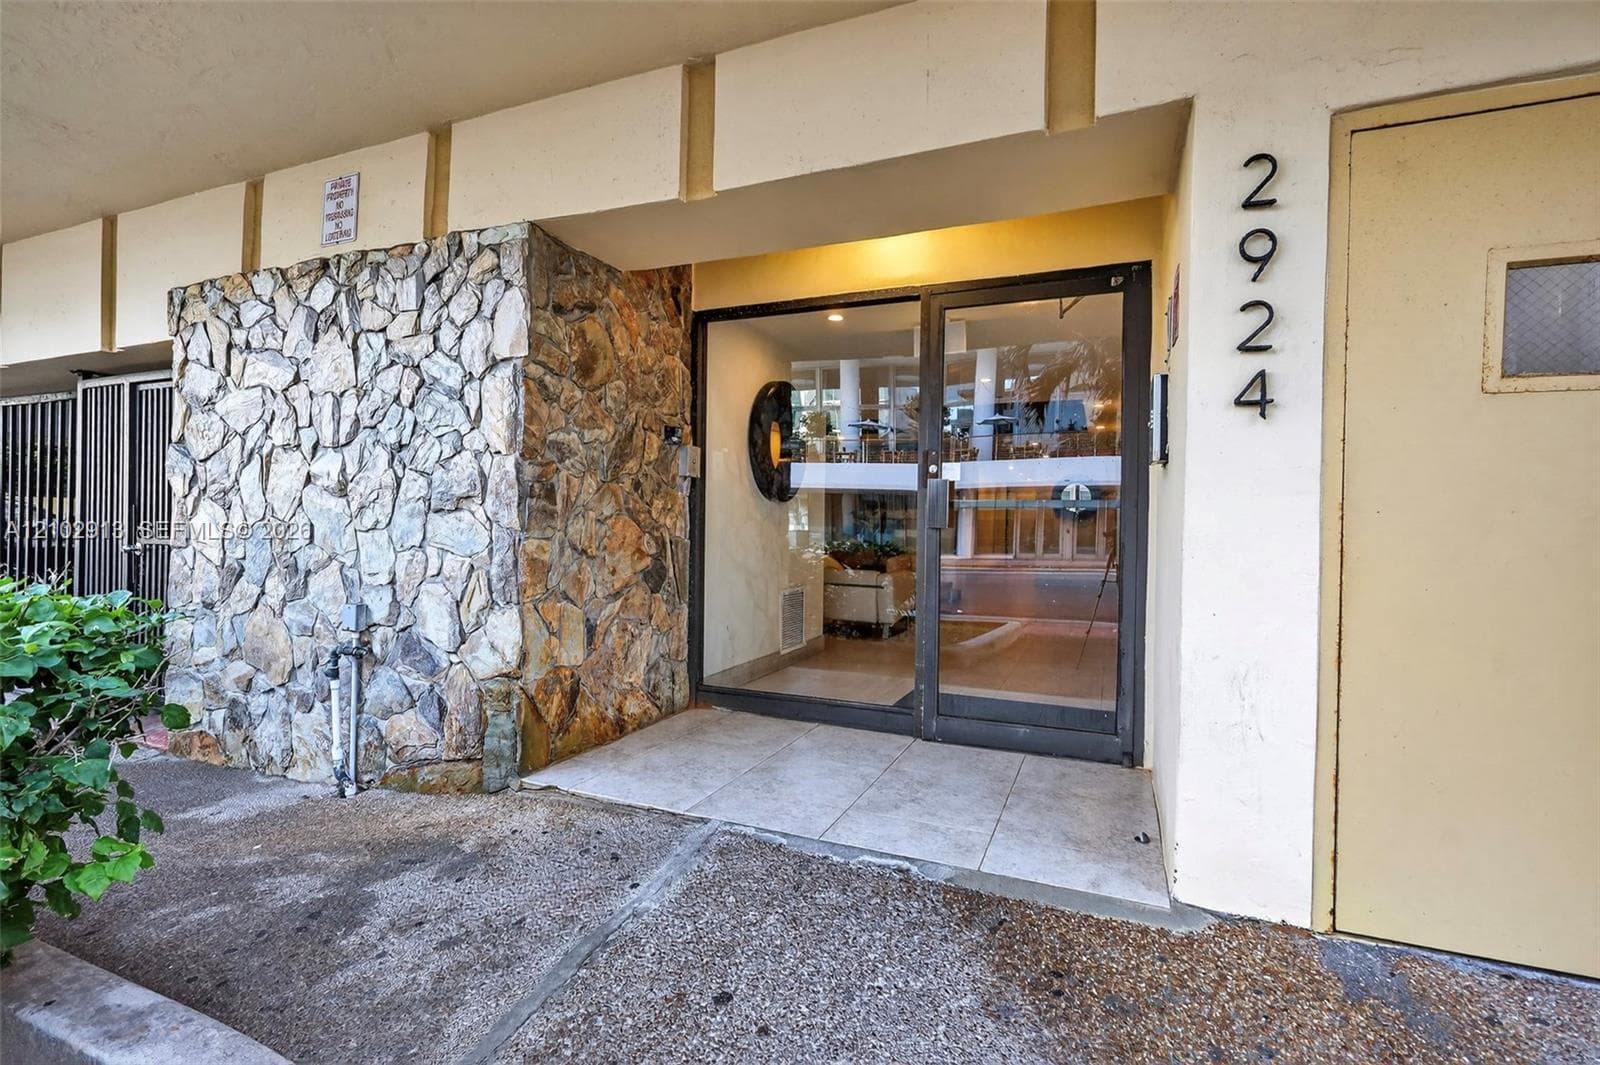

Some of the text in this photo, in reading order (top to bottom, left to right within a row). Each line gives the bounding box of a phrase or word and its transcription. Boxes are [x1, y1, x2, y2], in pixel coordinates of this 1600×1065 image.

[335, 200, 344, 210] NO
[335, 221, 343, 230] NO
[1233, 152, 1279, 420] 2924
